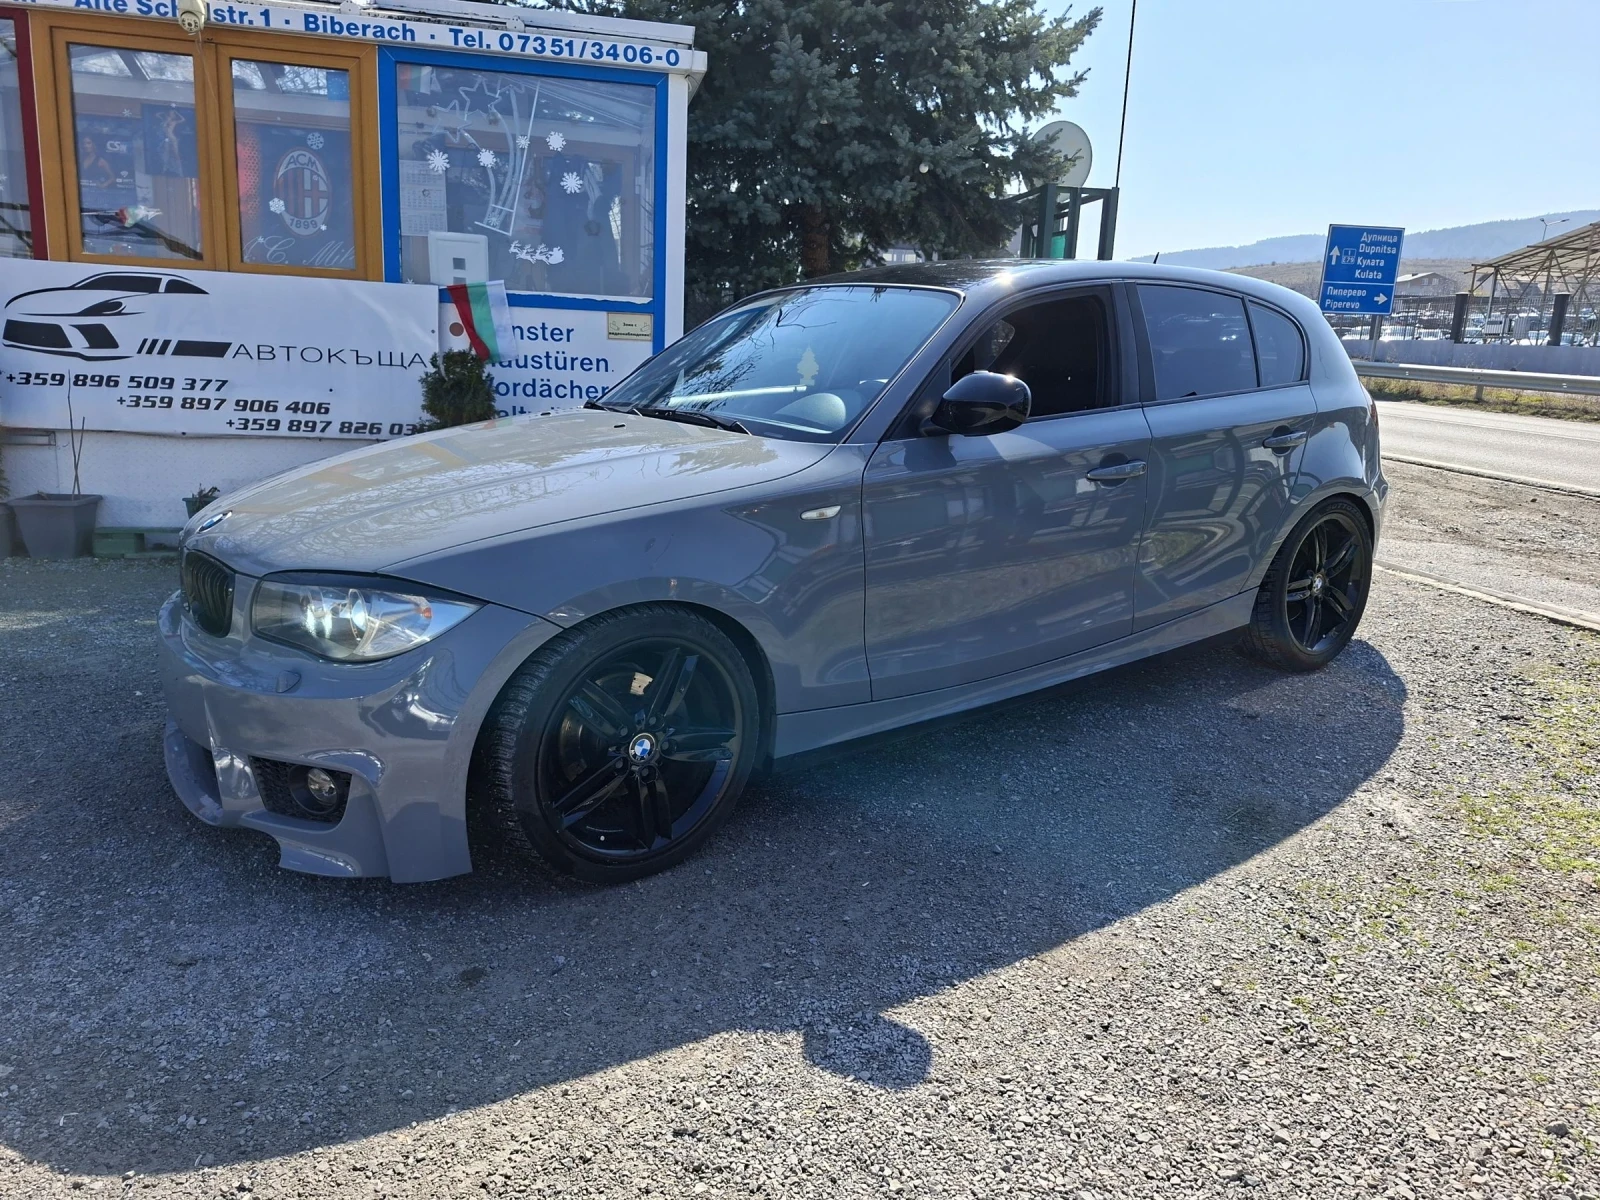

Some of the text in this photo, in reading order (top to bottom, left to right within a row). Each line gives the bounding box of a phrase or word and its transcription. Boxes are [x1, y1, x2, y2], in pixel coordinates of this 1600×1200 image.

[136, 0, 254, 25] Sclstr.
[259, 8, 271, 27] 1
[303, 13, 416, 41] Biberach
[448, 28, 492, 49] Tel.
[499, 33, 681, 67] 07351/3406-0
[284, 153, 320, 173] ACM
[289, 218, 319, 230] 1899
[1360, 231, 1398, 243] Дупница
[1358, 243, 1397, 255] Dupnitsa
[1356, 257, 1385, 268] Кулата
[1354, 269, 1382, 280] Kulata
[1327, 286, 1367, 298] Пиперево
[1324, 299, 1360, 310] Piperevo
[511, 322, 575, 343] nster
[232, 342, 428, 370] АВТОКЪЩА
[490, 351, 615, 373] austüren.
[6, 372, 230, 392] +359 896 509 377
[489, 378, 610, 400] ordächer
[116, 395, 332, 415] +359 897 906 406
[226, 418, 419, 437] +359 897 826 03
